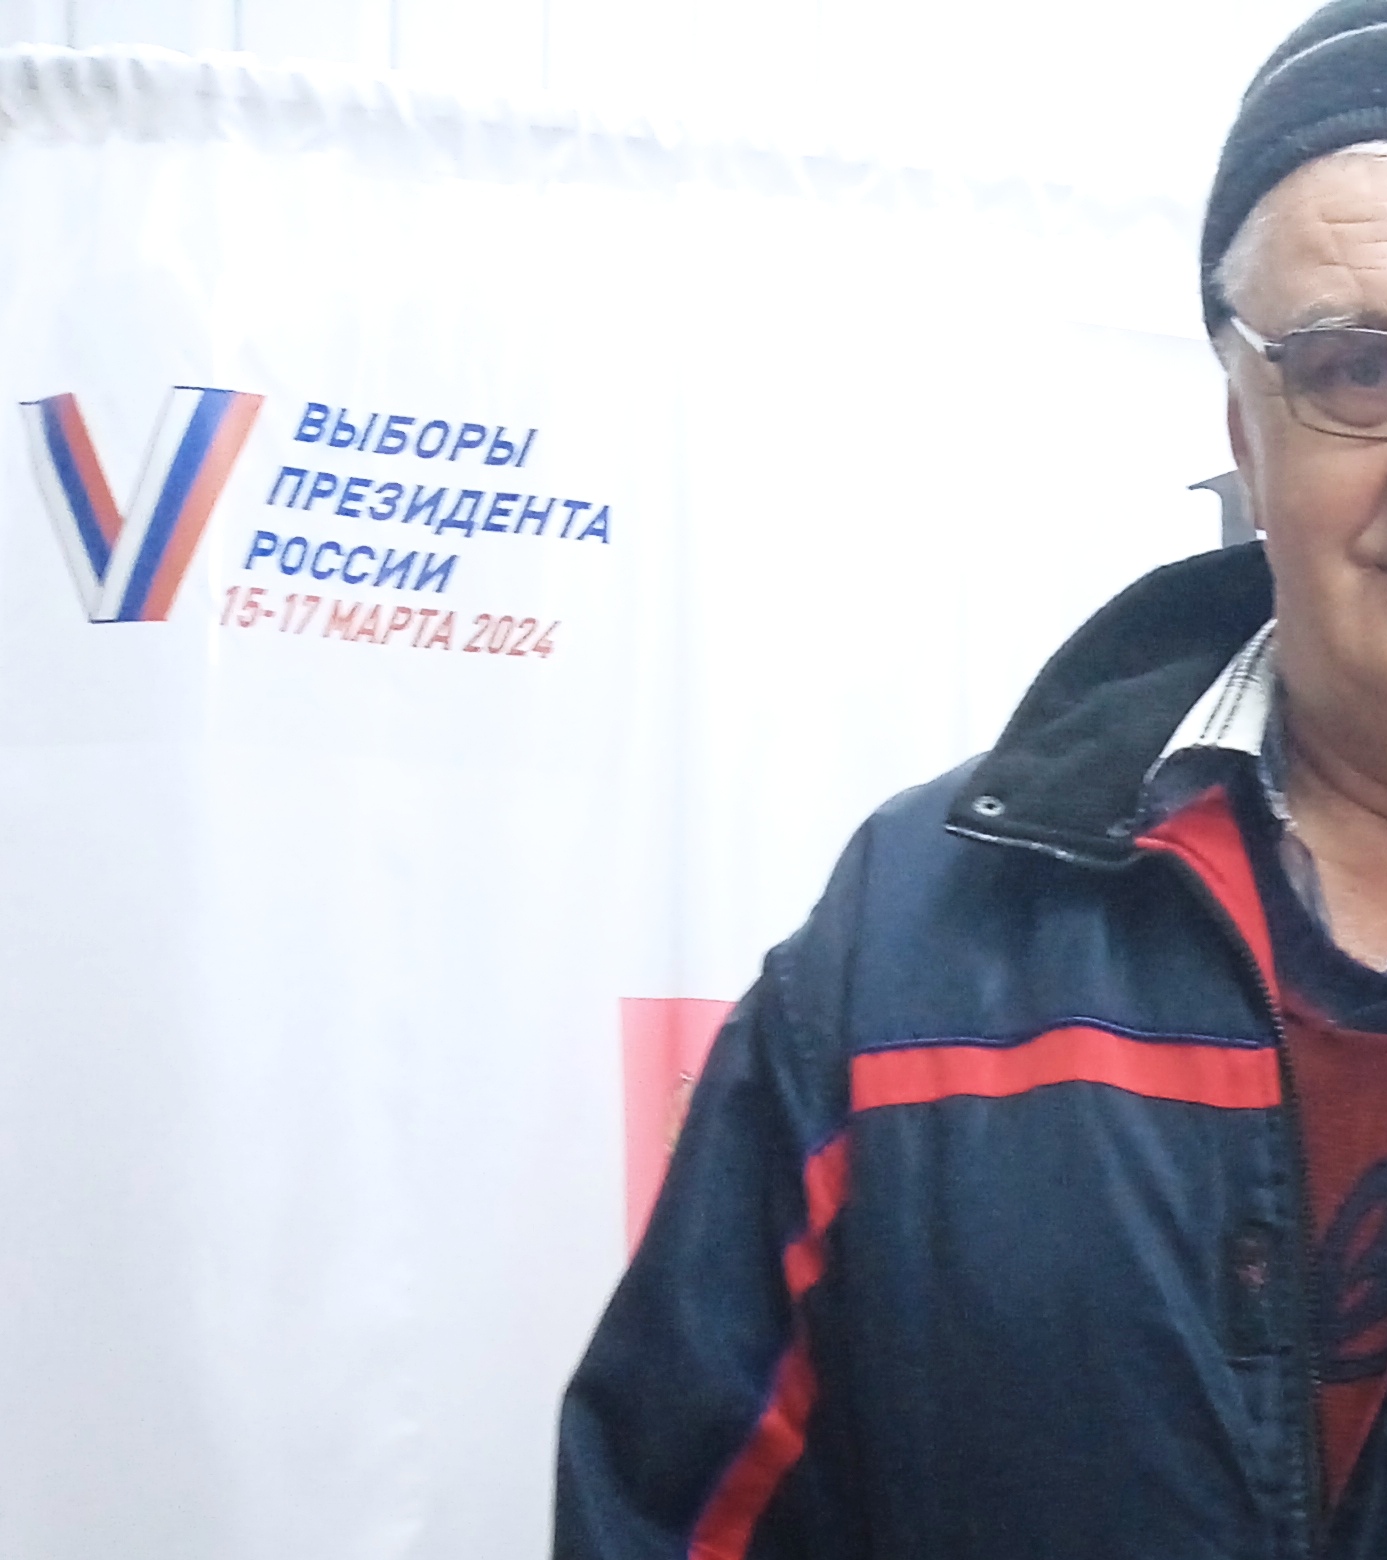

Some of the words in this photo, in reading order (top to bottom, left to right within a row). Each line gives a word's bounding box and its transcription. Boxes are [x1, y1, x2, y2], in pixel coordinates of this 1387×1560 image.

[294, 402, 538, 467] ВЫБОРЫ
[266, 466, 611, 543] ПРЕЗИДЕНТА
[244, 531, 457, 593] РОССИИ
[219, 586, 321, 635] 15-17
[321, 601, 457, 651] МАРТА
[462, 614, 561, 658] 2024
